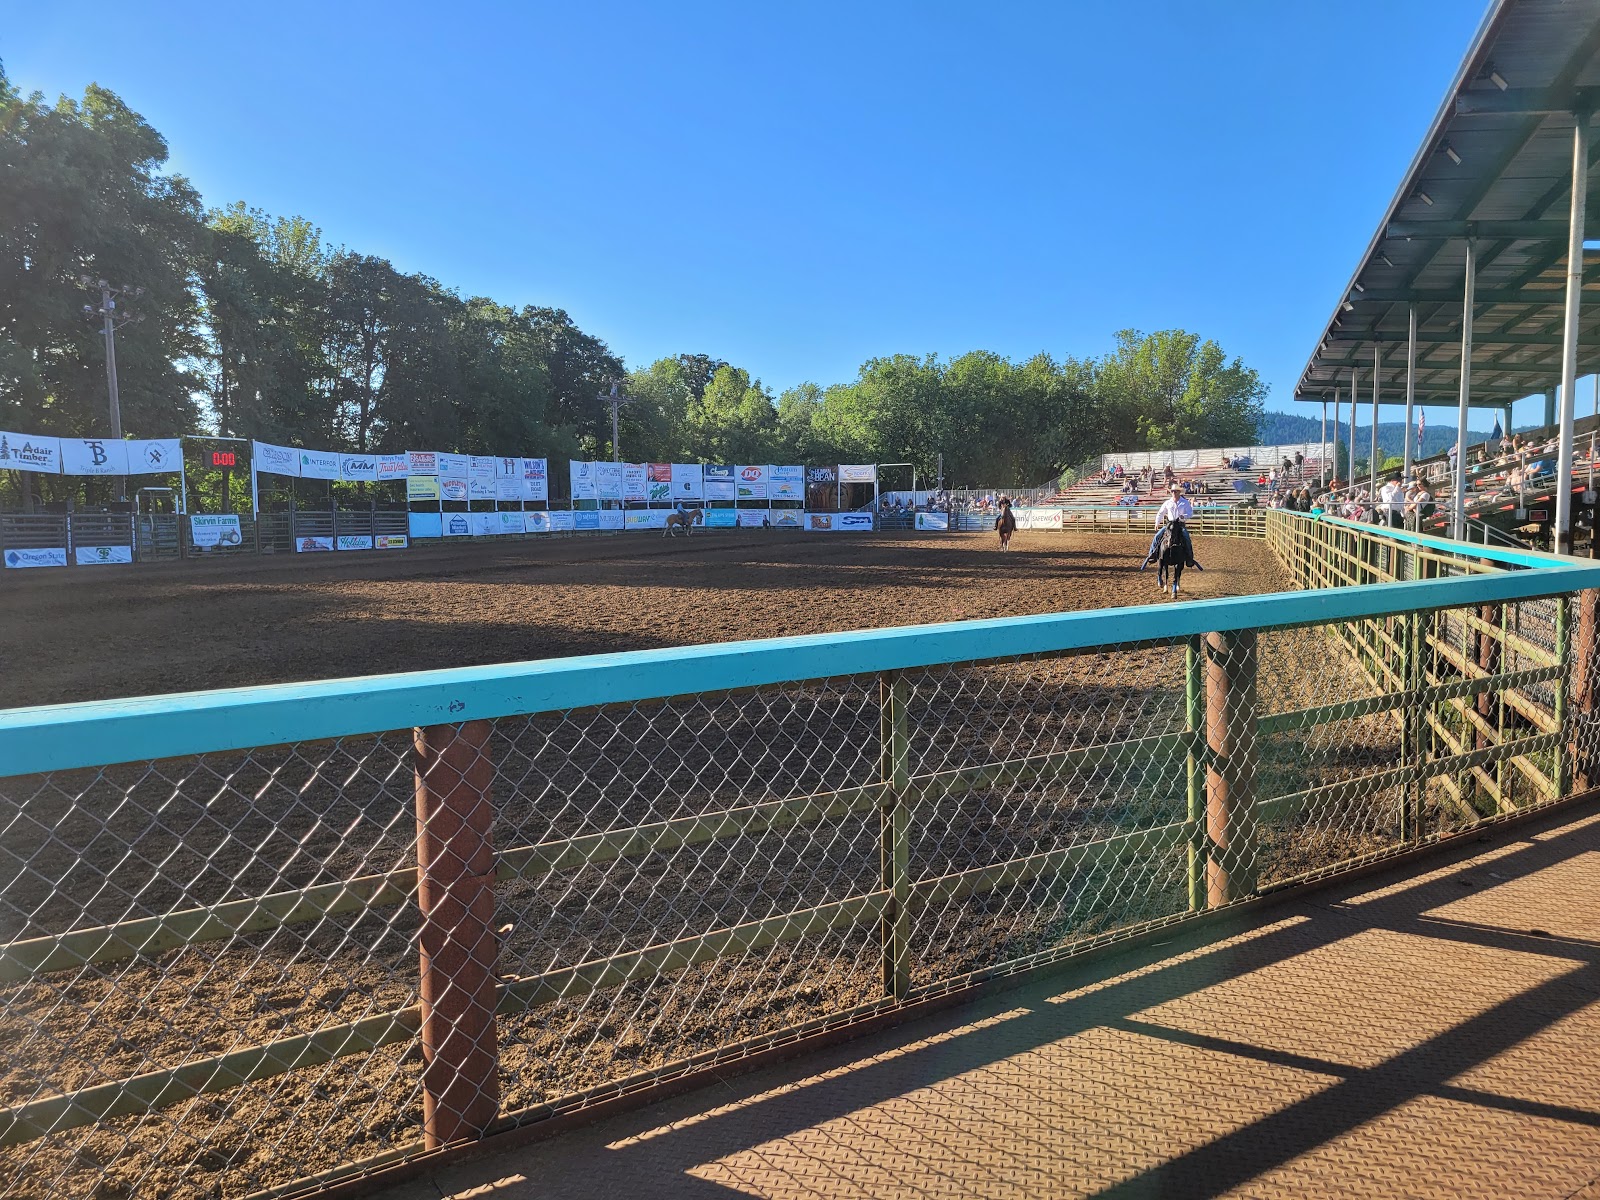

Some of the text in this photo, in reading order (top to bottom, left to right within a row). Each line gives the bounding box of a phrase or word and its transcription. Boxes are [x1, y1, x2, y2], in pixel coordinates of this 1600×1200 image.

[23, 442, 52, 455] Adair
[11, 448, 48, 462] Timber
[378, 462, 394, 473] True
[815, 473, 835, 481] BEAN
[217, 516, 237, 525] Farms
[626, 515, 650, 523] SUBWAY
[22, 553, 46, 561] Oregon
